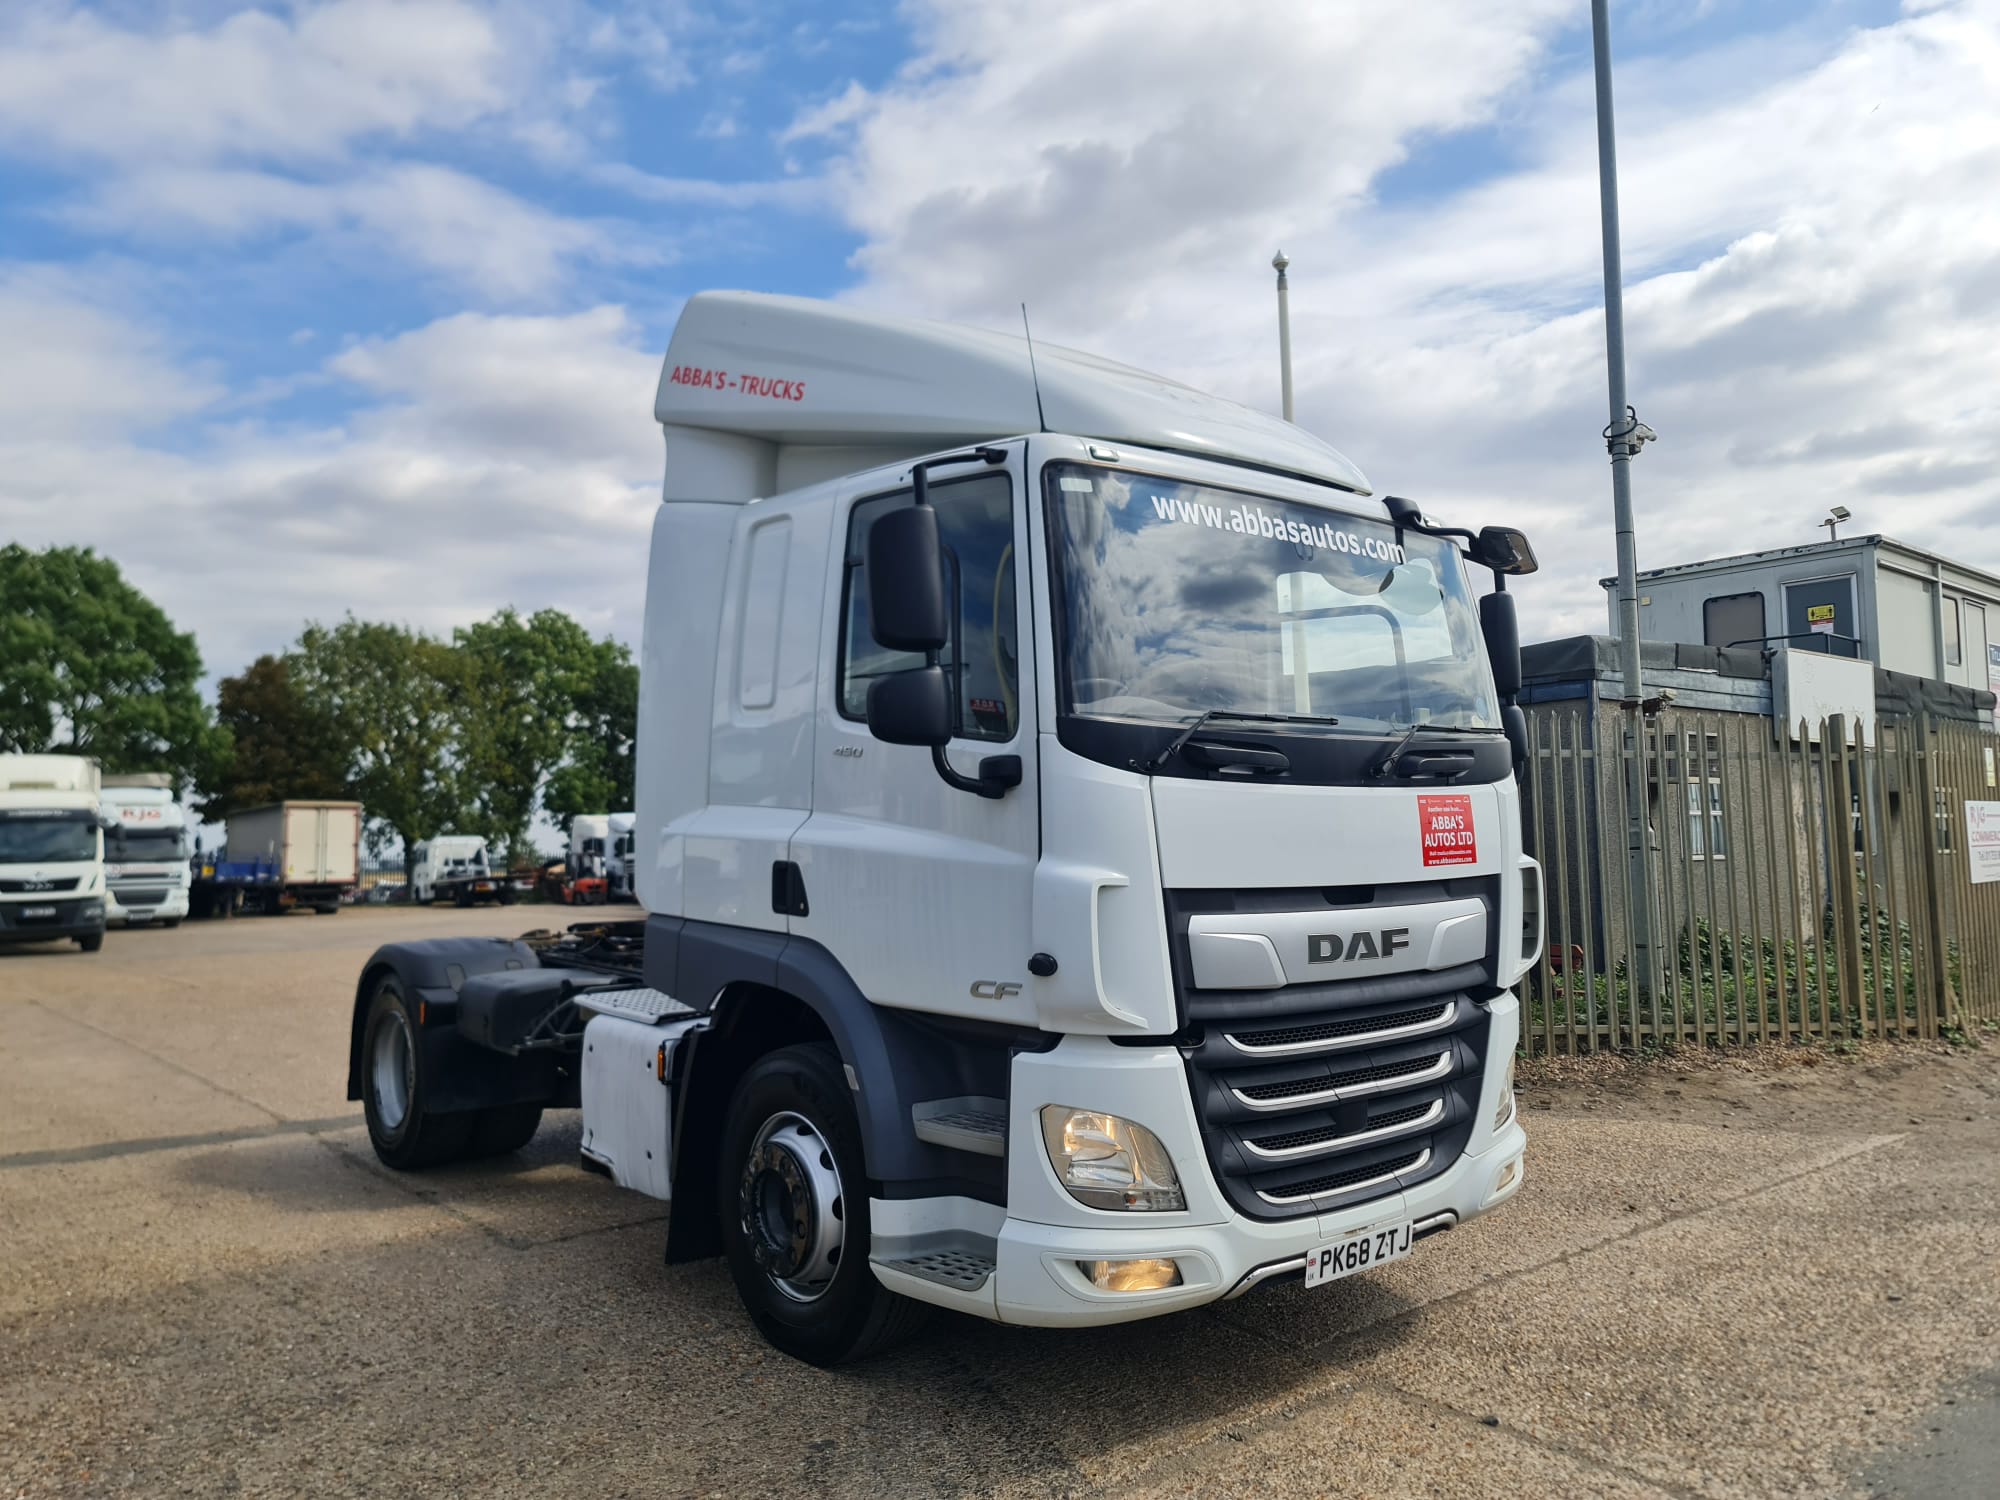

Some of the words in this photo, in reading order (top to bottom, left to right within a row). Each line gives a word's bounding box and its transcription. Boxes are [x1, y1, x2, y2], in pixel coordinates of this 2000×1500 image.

[670, 366, 727, 390] ABBA'S
[739, 375, 806, 401] TRUCKS
[1150, 495, 1407, 565] www.abbasautos.com
[832, 746, 864, 759] 450
[1431, 814, 1465, 830] ABBA'S
[1424, 832, 1456, 848] AUTOS
[1457, 831, 1473, 846] LTD
[1307, 927, 1410, 964] DAF
[970, 980, 1023, 1000] CF
[1319, 1238, 1370, 1279] PK68
[1375, 1225, 1410, 1261] ZTJ
